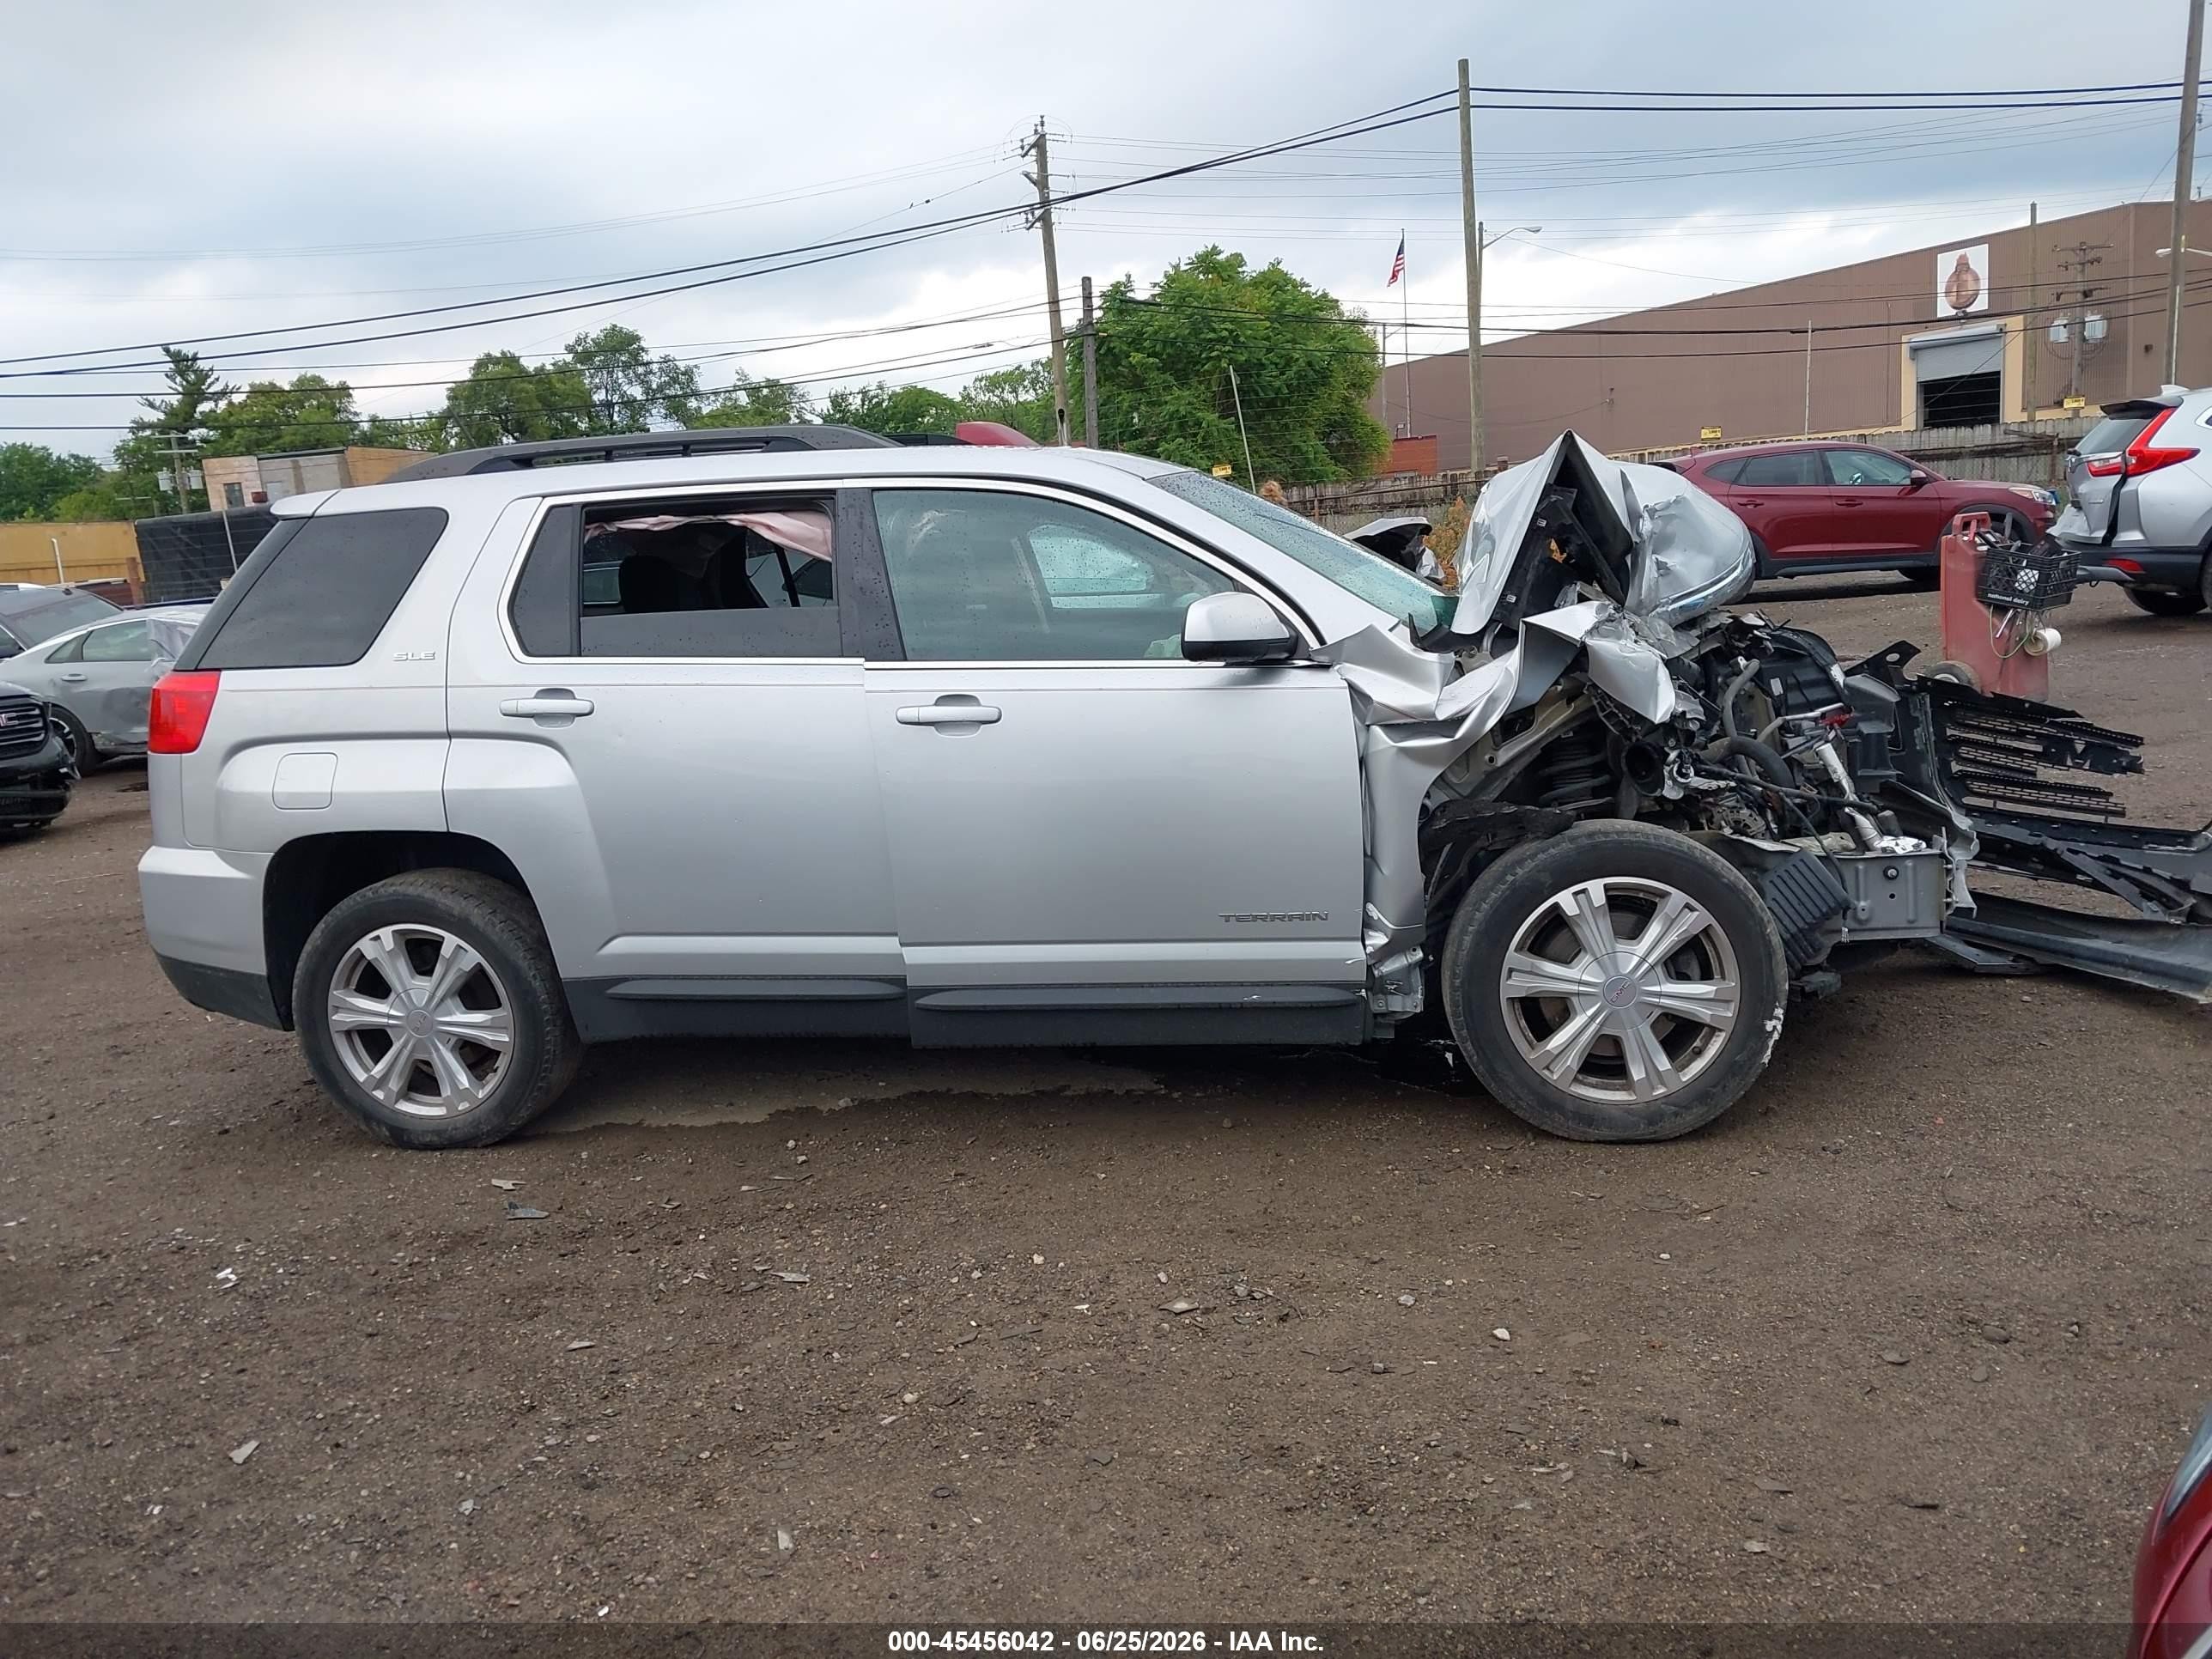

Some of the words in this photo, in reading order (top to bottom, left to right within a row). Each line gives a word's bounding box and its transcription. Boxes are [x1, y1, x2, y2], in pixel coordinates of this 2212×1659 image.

[1987, 592, 2013, 602] national
[2013, 597, 2029, 606] dairy
[392, 652, 436, 661] SLE
[1218, 911, 1329, 923] TERRAIN
[1610, 979, 1631, 1003] GMC
